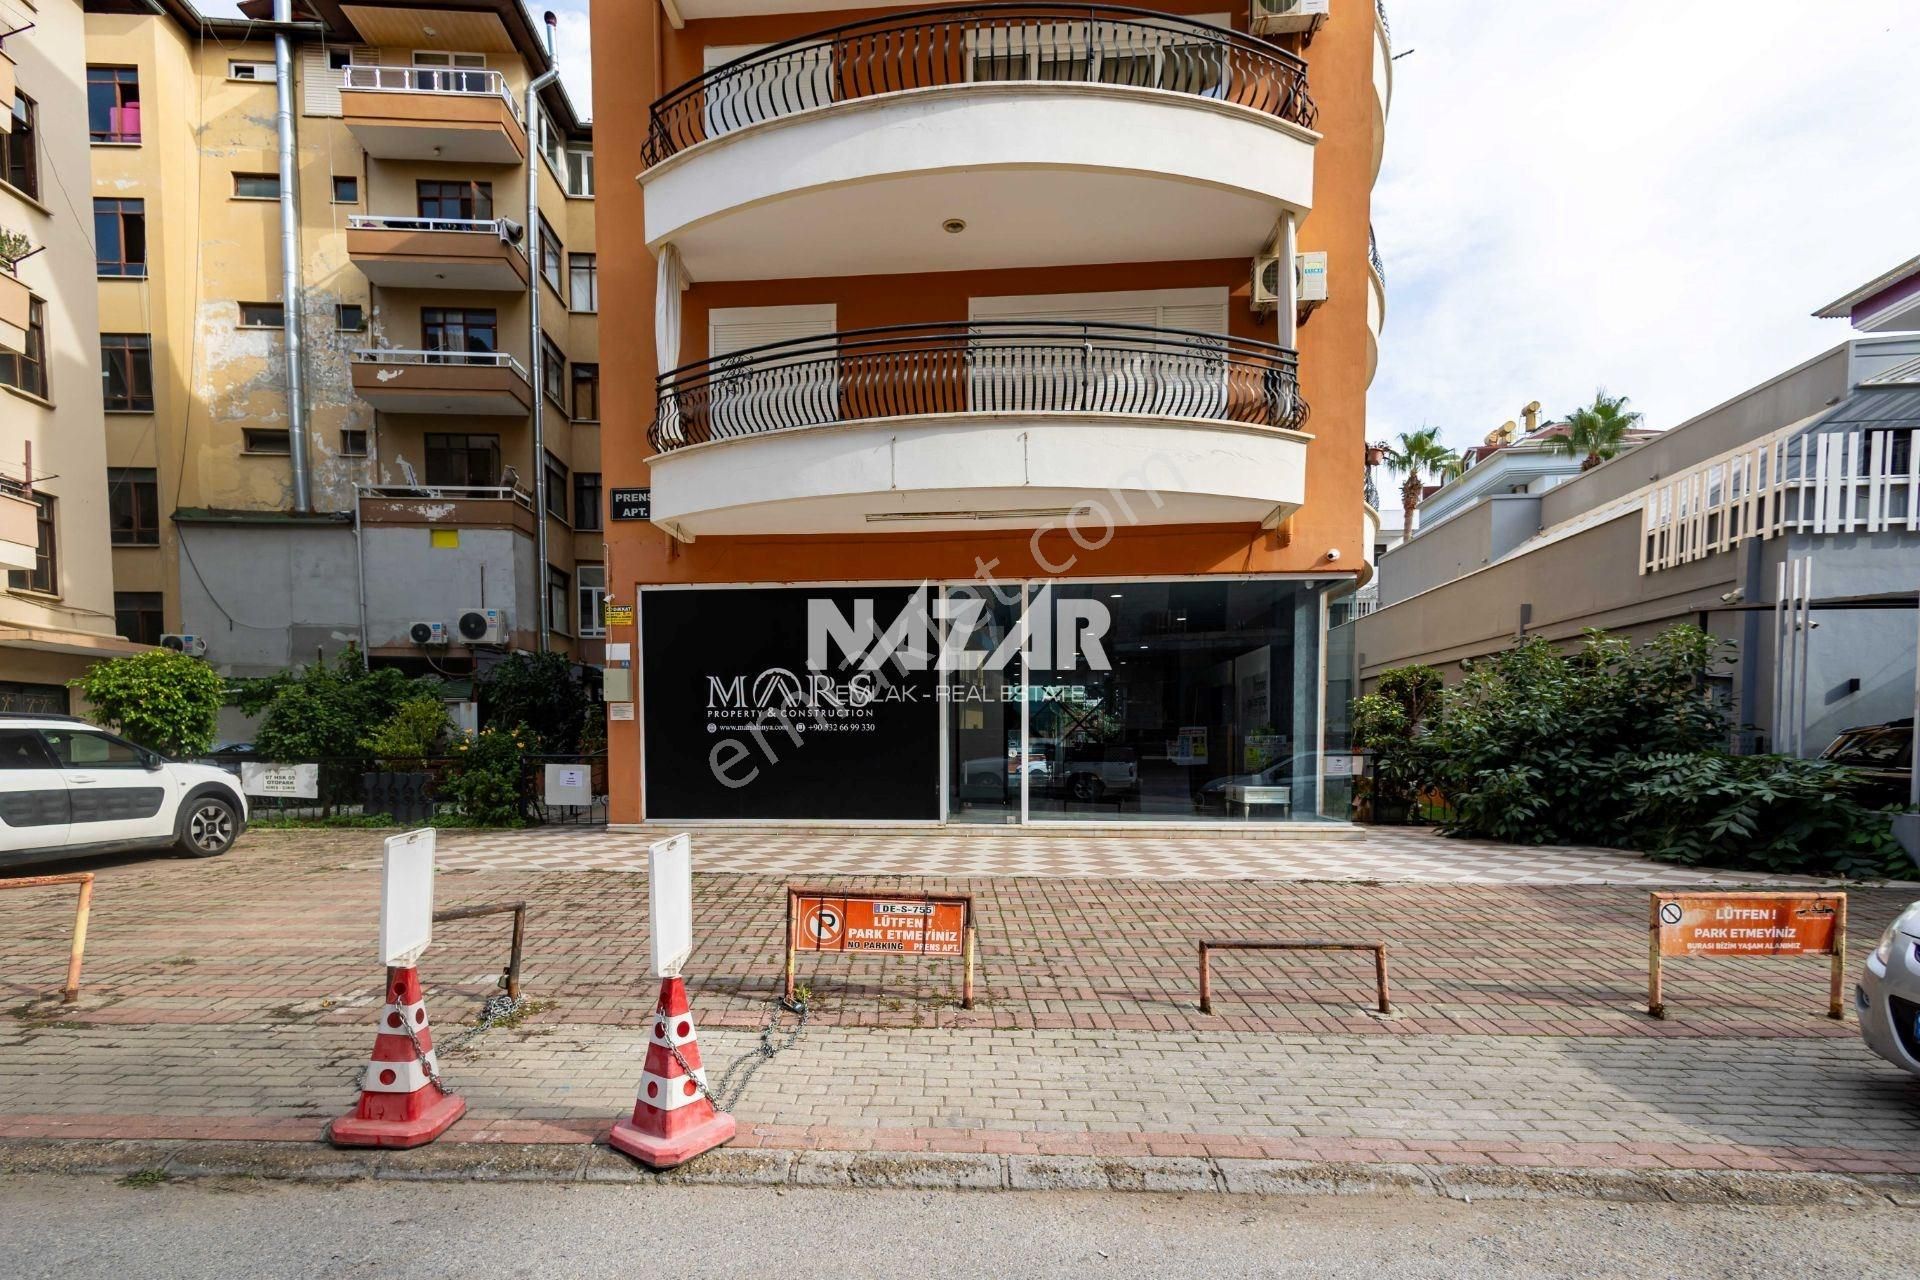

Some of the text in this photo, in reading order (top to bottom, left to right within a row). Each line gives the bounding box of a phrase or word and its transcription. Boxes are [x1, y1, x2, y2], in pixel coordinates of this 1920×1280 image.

[622, 507, 648, 517] APT.
[705, 667, 873, 708] MARS
[707, 706, 874, 718] PROPERTY & CONSTRUCTION
[850, 723, 860, 732] 99
[861, 723, 876, 732] 330
[882, 905, 932, 914] DE-S-755
[1715, 906, 1769, 920] LÜTFEN
[873, 914, 924, 928] LÜTFEN
[848, 928, 958, 943] PARK ETMEYİNİZ
[1694, 926, 1797, 939] PARK ETMEYİNİZ
[847, 941, 904, 951] NO PARKING
[942, 944, 959, 953] APT.
[1686, 942, 1715, 950] BURASI
[1737, 942, 1764, 951] YAŞAM
